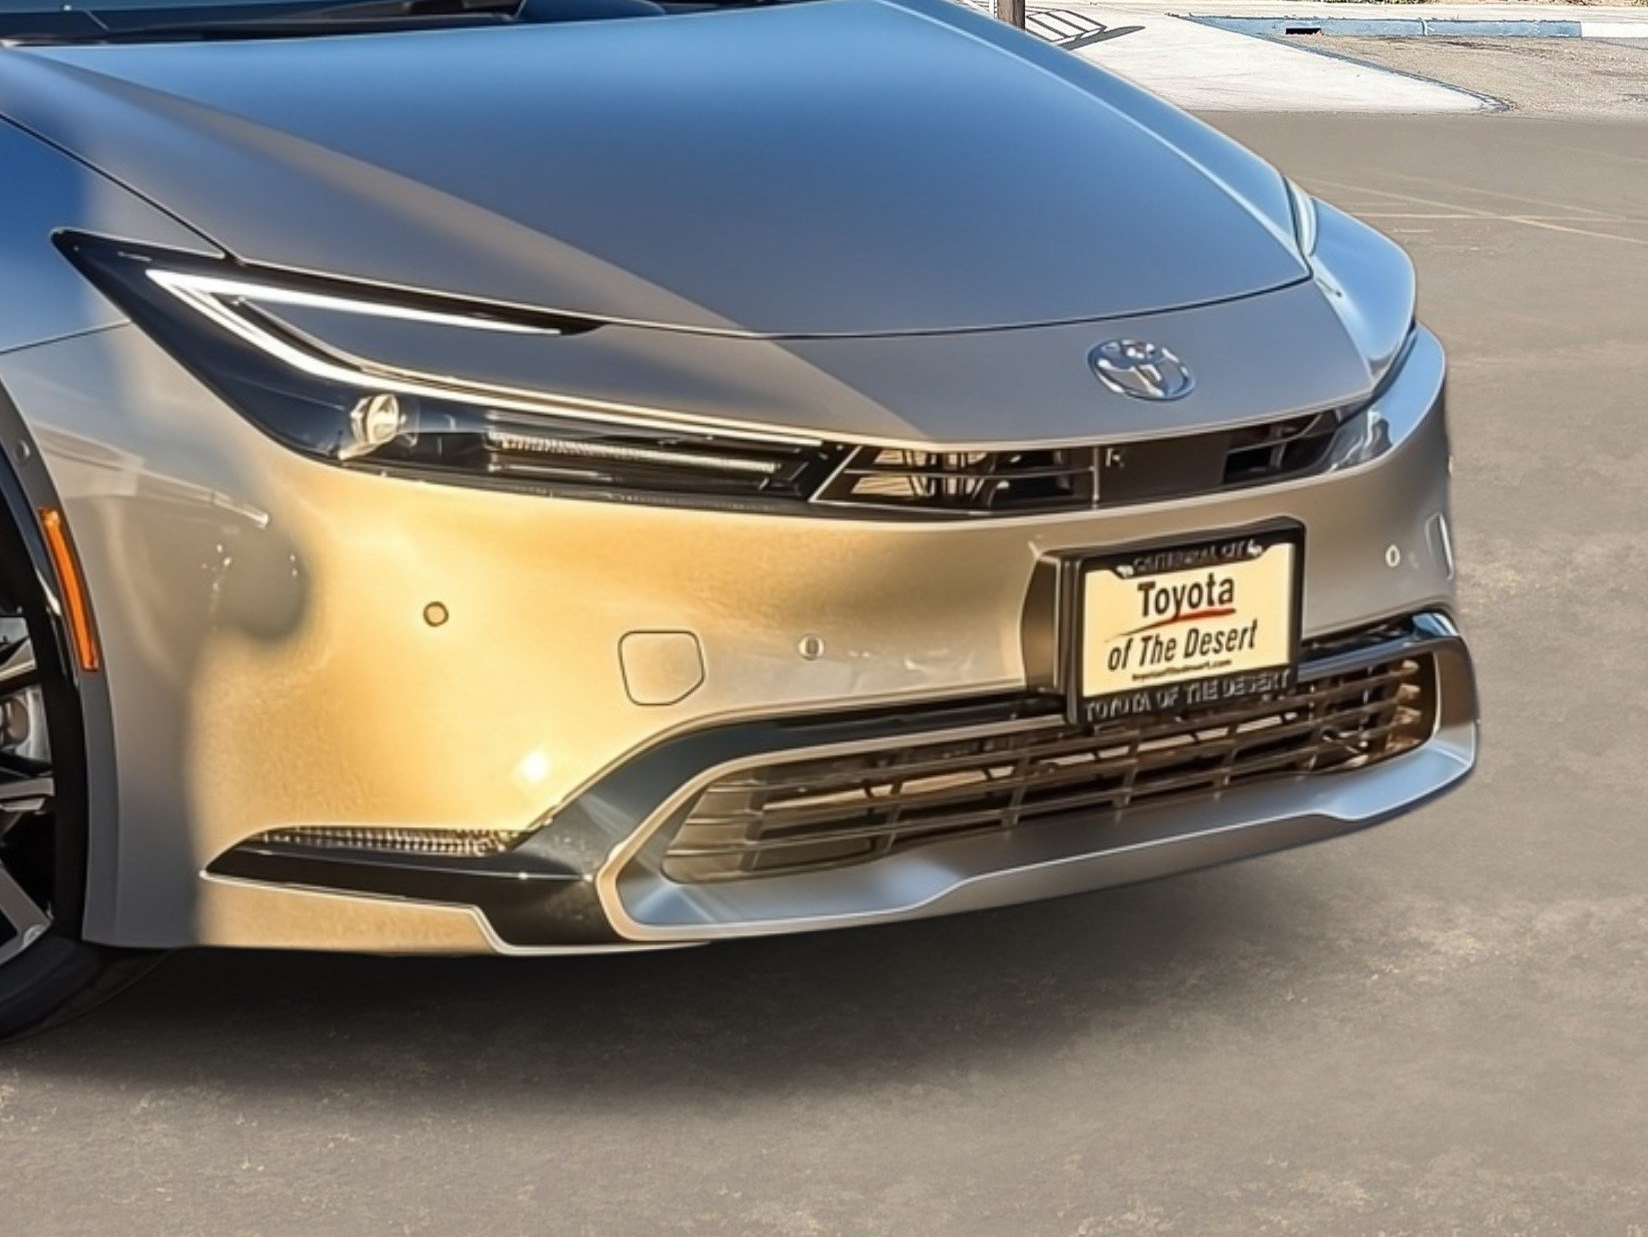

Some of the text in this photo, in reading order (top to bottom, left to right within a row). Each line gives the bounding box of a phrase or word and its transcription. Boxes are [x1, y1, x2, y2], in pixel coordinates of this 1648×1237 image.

[1137, 572, 1235, 619] Toyota
[1108, 618, 1258, 671] of The Desert
[1155, 686, 1181, 709] OF
